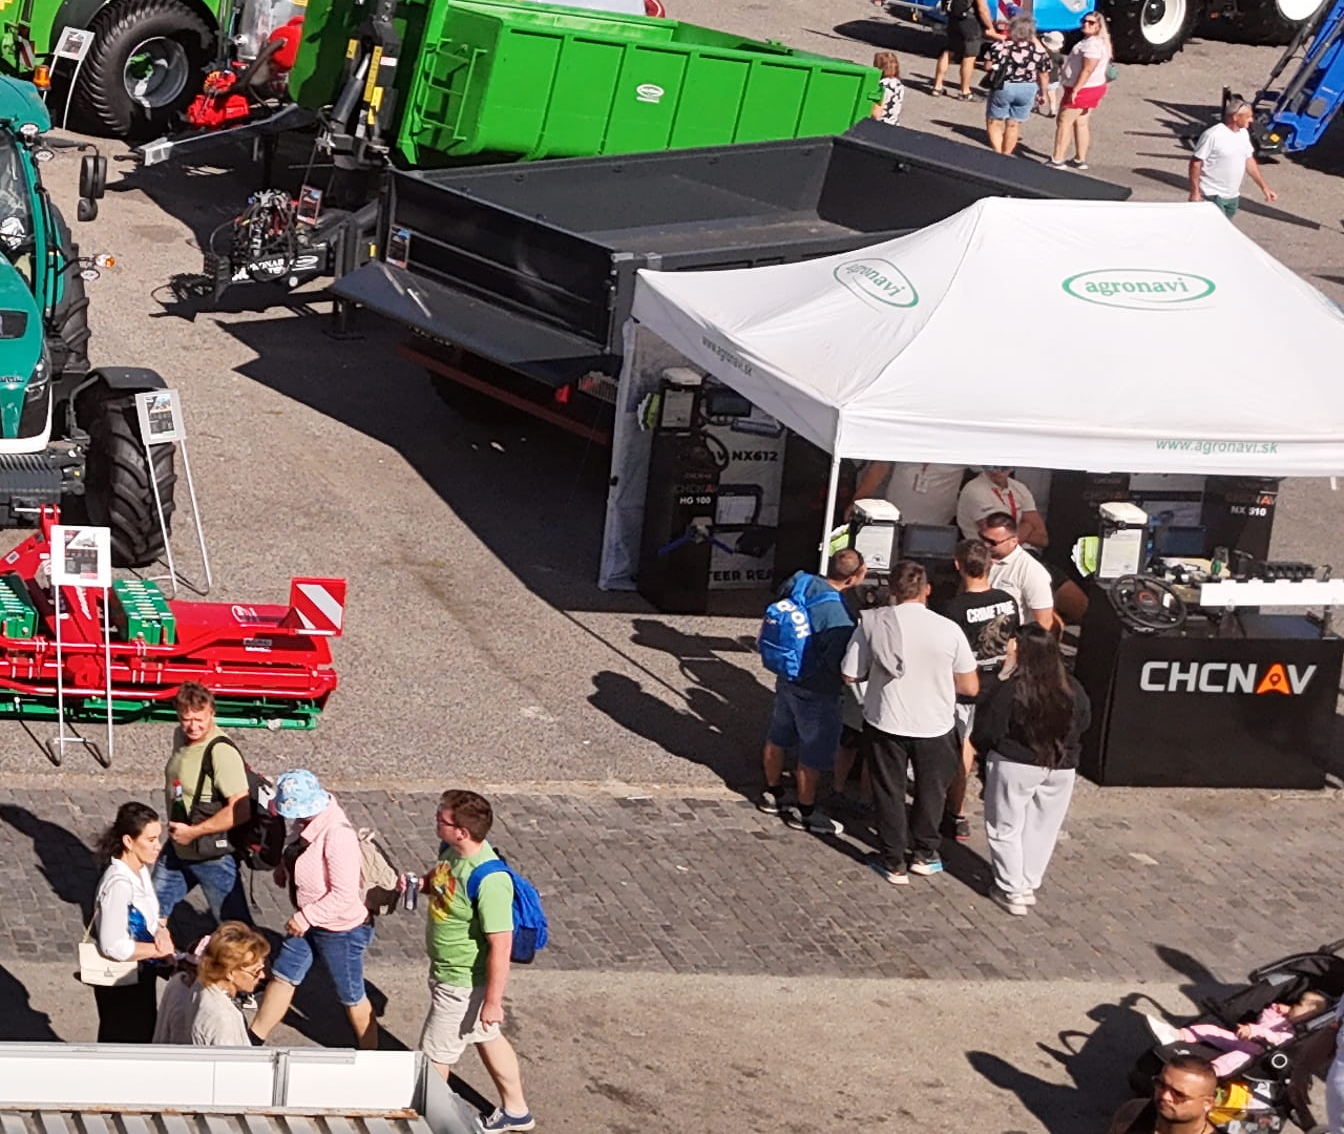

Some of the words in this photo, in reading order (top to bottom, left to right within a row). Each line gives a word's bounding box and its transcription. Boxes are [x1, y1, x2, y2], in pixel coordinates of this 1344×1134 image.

[1084, 277, 1189, 296] agronavi
[732, 450, 779, 462] NX612
[1155, 439, 1279, 456] www.agronavi.sk
[1230, 505, 1247, 515] NX
[1140, 661, 1318, 695] CHCNAV
